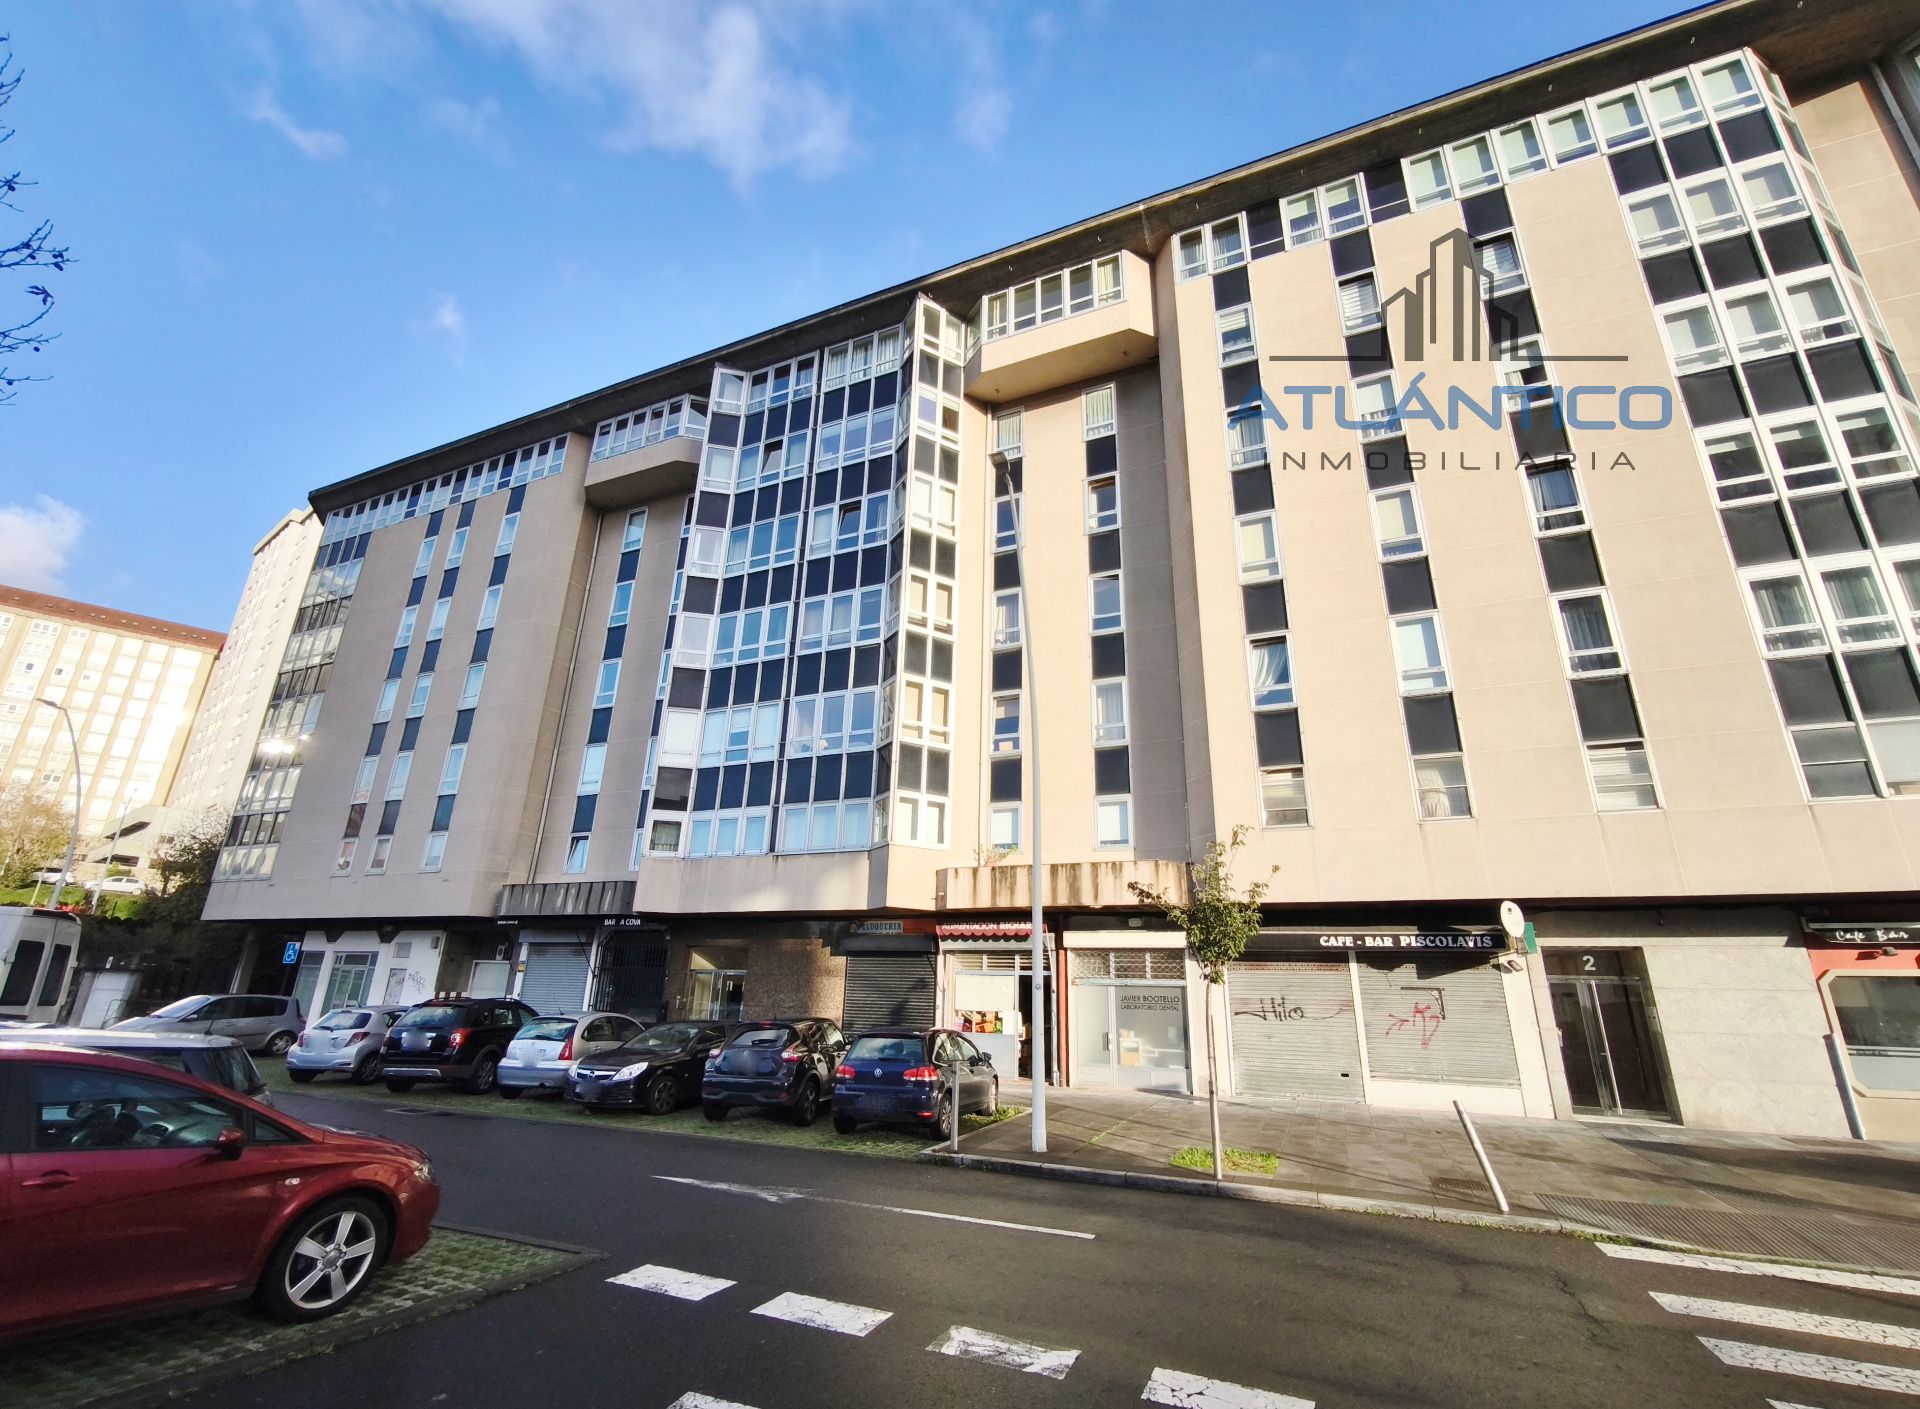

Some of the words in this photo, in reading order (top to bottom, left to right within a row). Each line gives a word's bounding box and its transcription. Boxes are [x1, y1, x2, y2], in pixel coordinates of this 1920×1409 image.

[999, 922, 1032, 930] RICHAR
[1319, 936, 1354, 947] CAFE
[1365, 937, 1393, 947] BAR
[1399, 936, 1492, 947] PISCOLAVIS
[1583, 955, 1596, 970] 2
